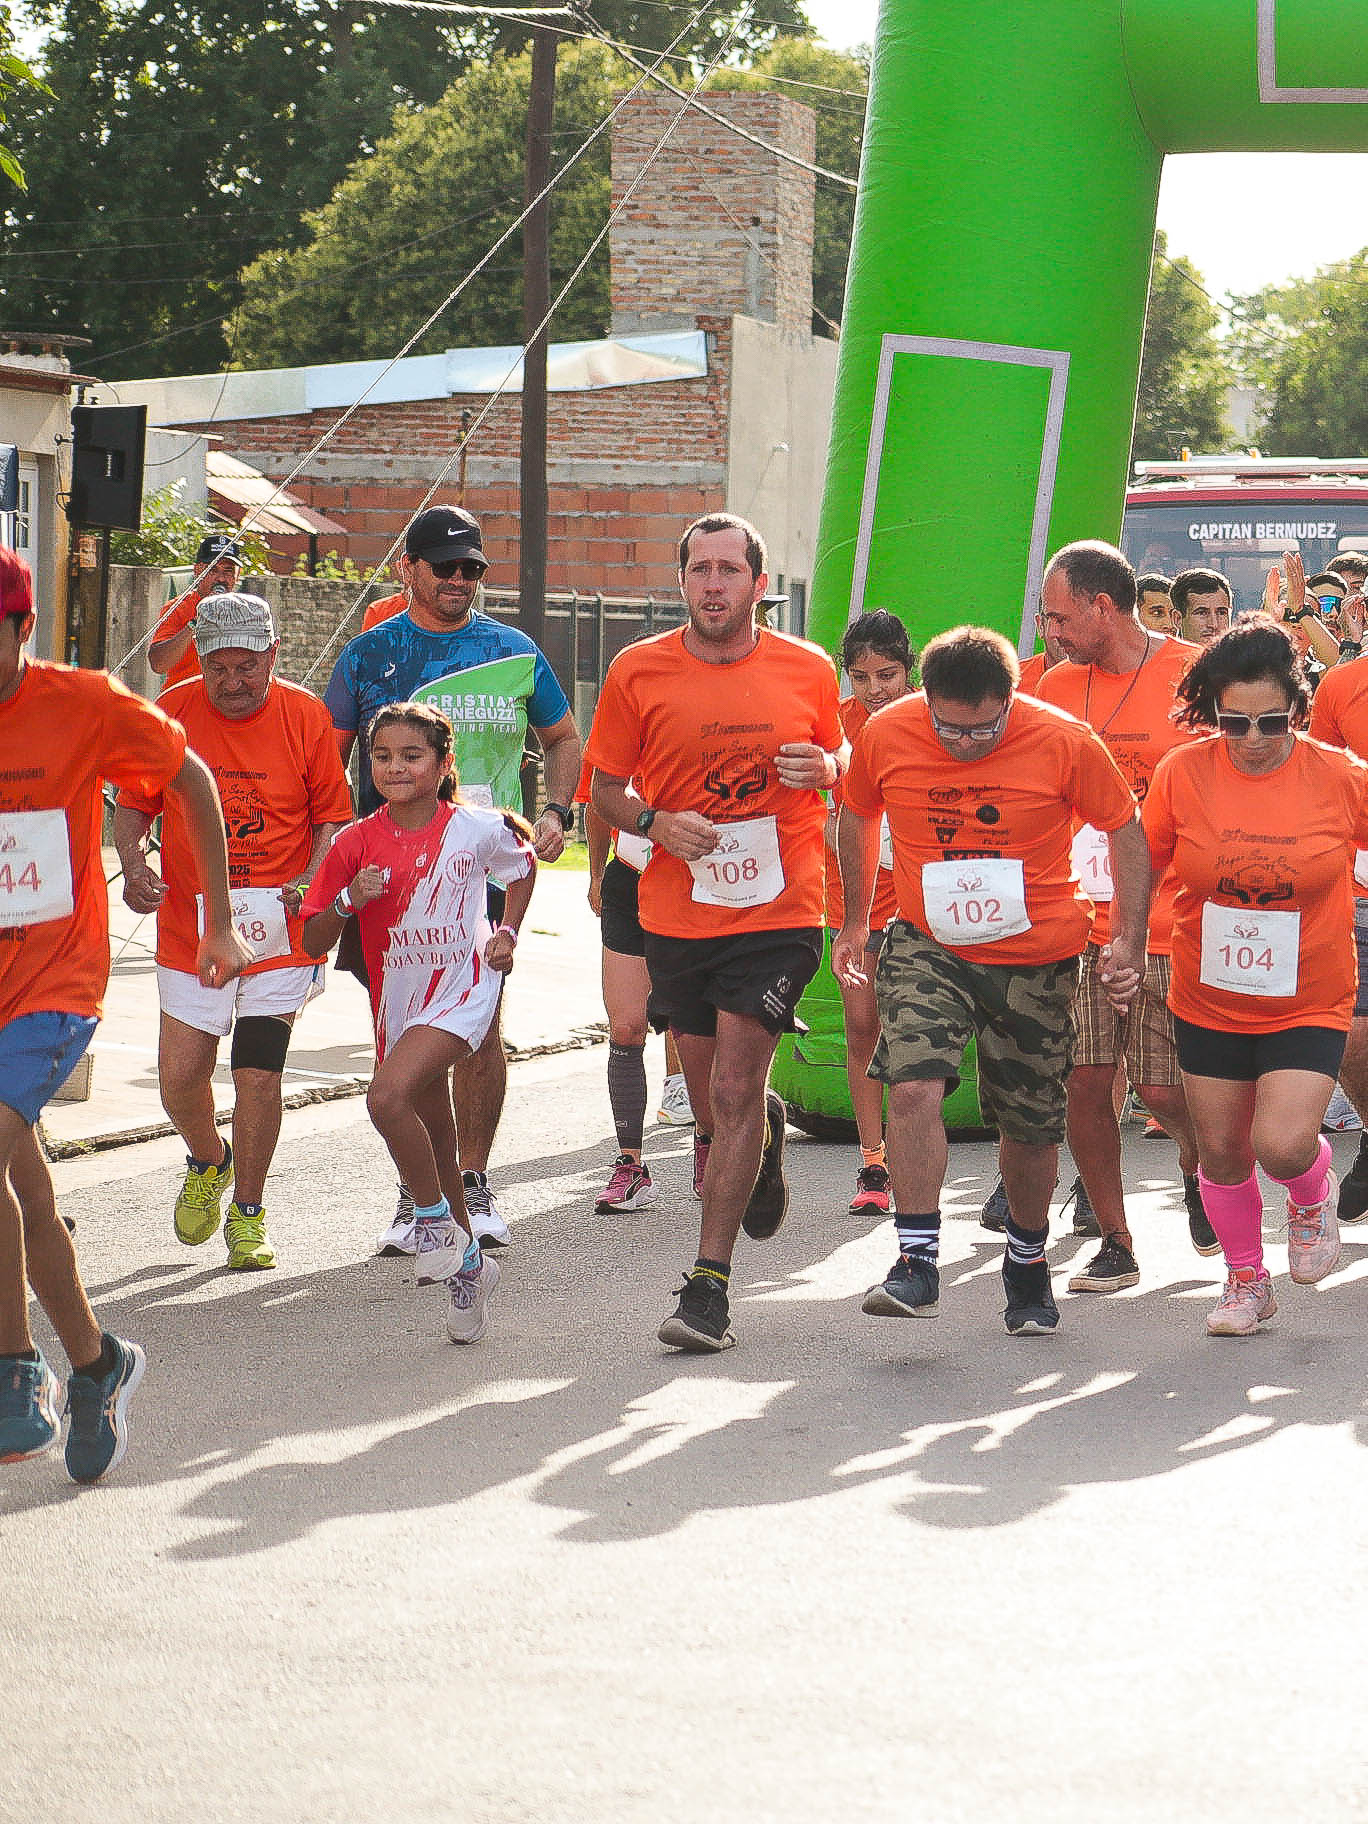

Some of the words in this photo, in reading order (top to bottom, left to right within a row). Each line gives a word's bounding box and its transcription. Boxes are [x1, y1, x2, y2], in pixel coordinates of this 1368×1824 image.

[1189, 523, 1252, 540] CAPITAN
[1255, 522, 1337, 539] BERMUDEZ
[707, 857, 759, 884] 108
[946, 899, 1003, 926] 102
[391, 921, 468, 947] MAREA
[1218, 944, 1275, 972] 104
